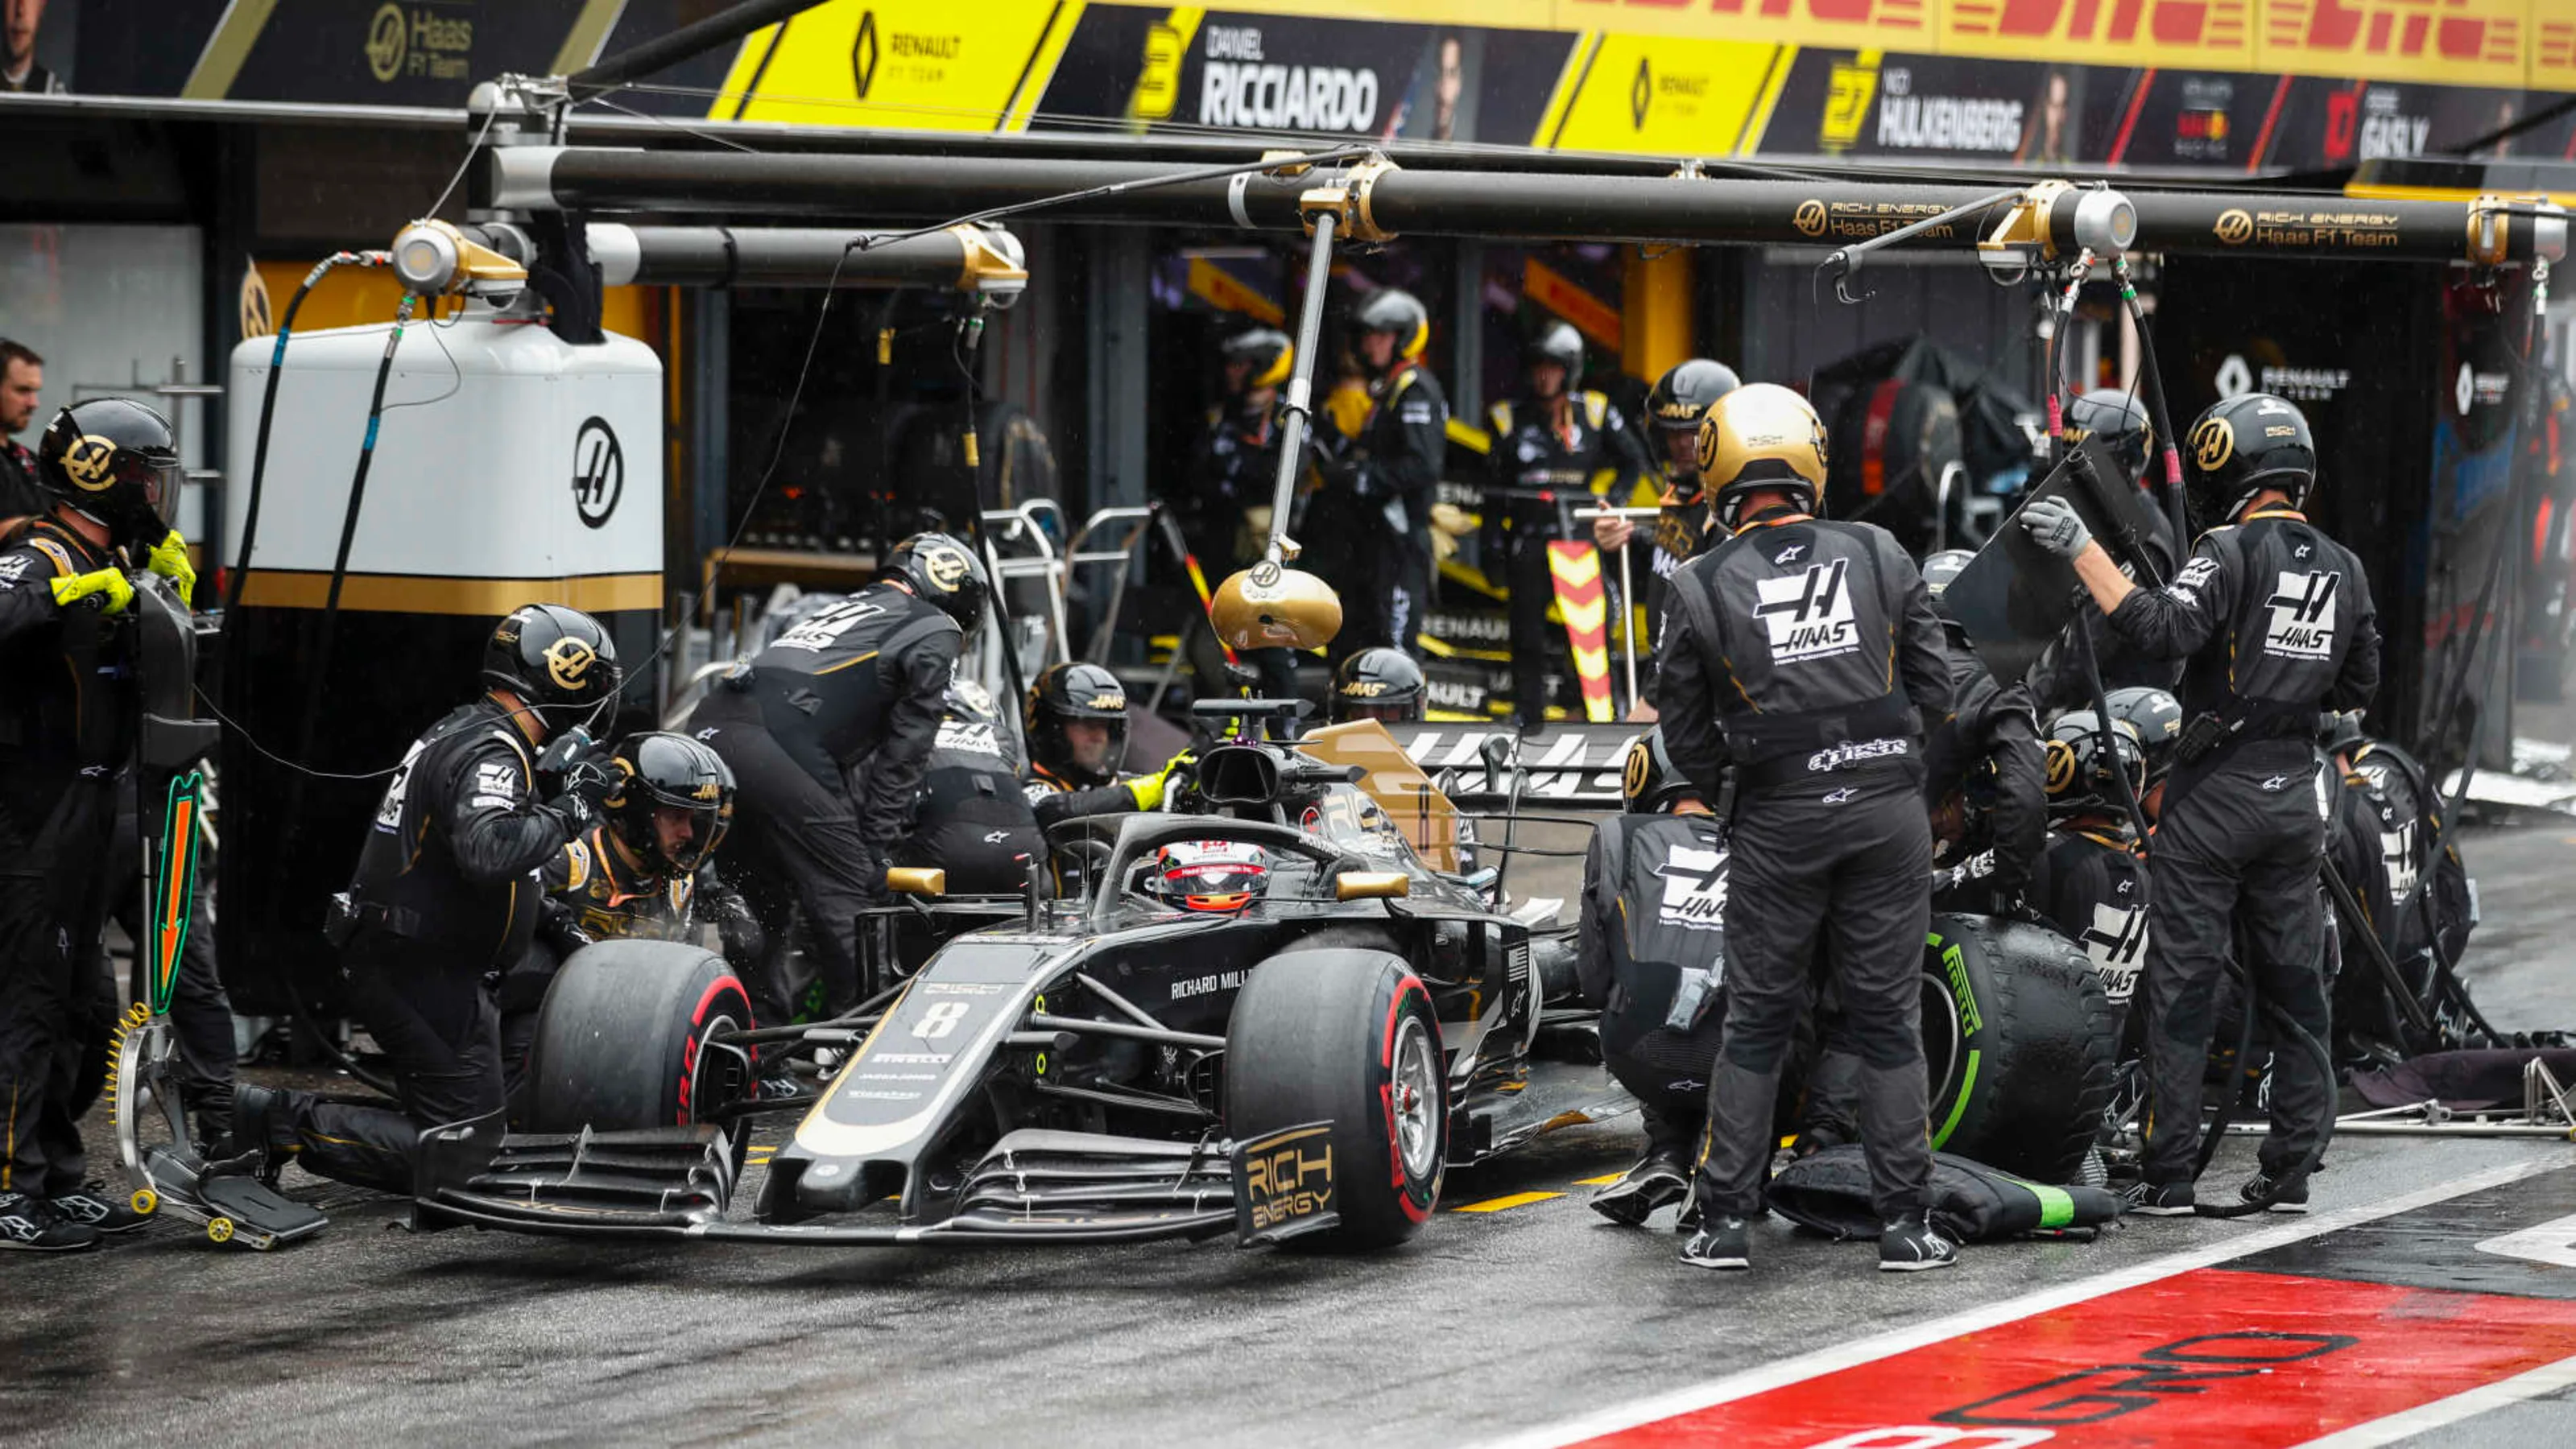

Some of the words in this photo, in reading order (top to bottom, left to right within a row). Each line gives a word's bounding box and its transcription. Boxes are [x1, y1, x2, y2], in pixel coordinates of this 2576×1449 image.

[409, 10, 473, 51] Haas
[1208, 27, 1264, 61] DANIEL
[891, 33, 961, 59] RENAULT
[1134, 22, 1180, 119] 3
[1199, 61, 1379, 131] RICCIARDO
[1877, 97, 2024, 151] HULKENBERG
[1831, 202, 1871, 213] RICH
[1877, 203, 1954, 213] ENERGY
[2256, 212, 2305, 223] RICH
[2310, 213, 2398, 225] ENERGY
[1831, 219, 1877, 236] Haas
[1903, 219, 1954, 238] Tam
[2256, 228, 2309, 244] Haas
[2314, 229, 2336, 244] F1
[2342, 229, 2398, 246] Team
[2261, 367, 2350, 388] RENAULT
[1420, 613, 1511, 641] RENAUL
[1772, 618, 1855, 653] HAAS
[2268, 626, 2334, 649] HAAS
[1339, 682, 1387, 697] HAAS
[1427, 681, 1486, 708] AULT
[1662, 897, 1726, 918] HAA
[1171, 975, 1217, 1000] RICHARD
[912, 1002, 970, 1038] 8
[1247, 1144, 1332, 1201] RICH
[1252, 1187, 1332, 1228] ENERGY
